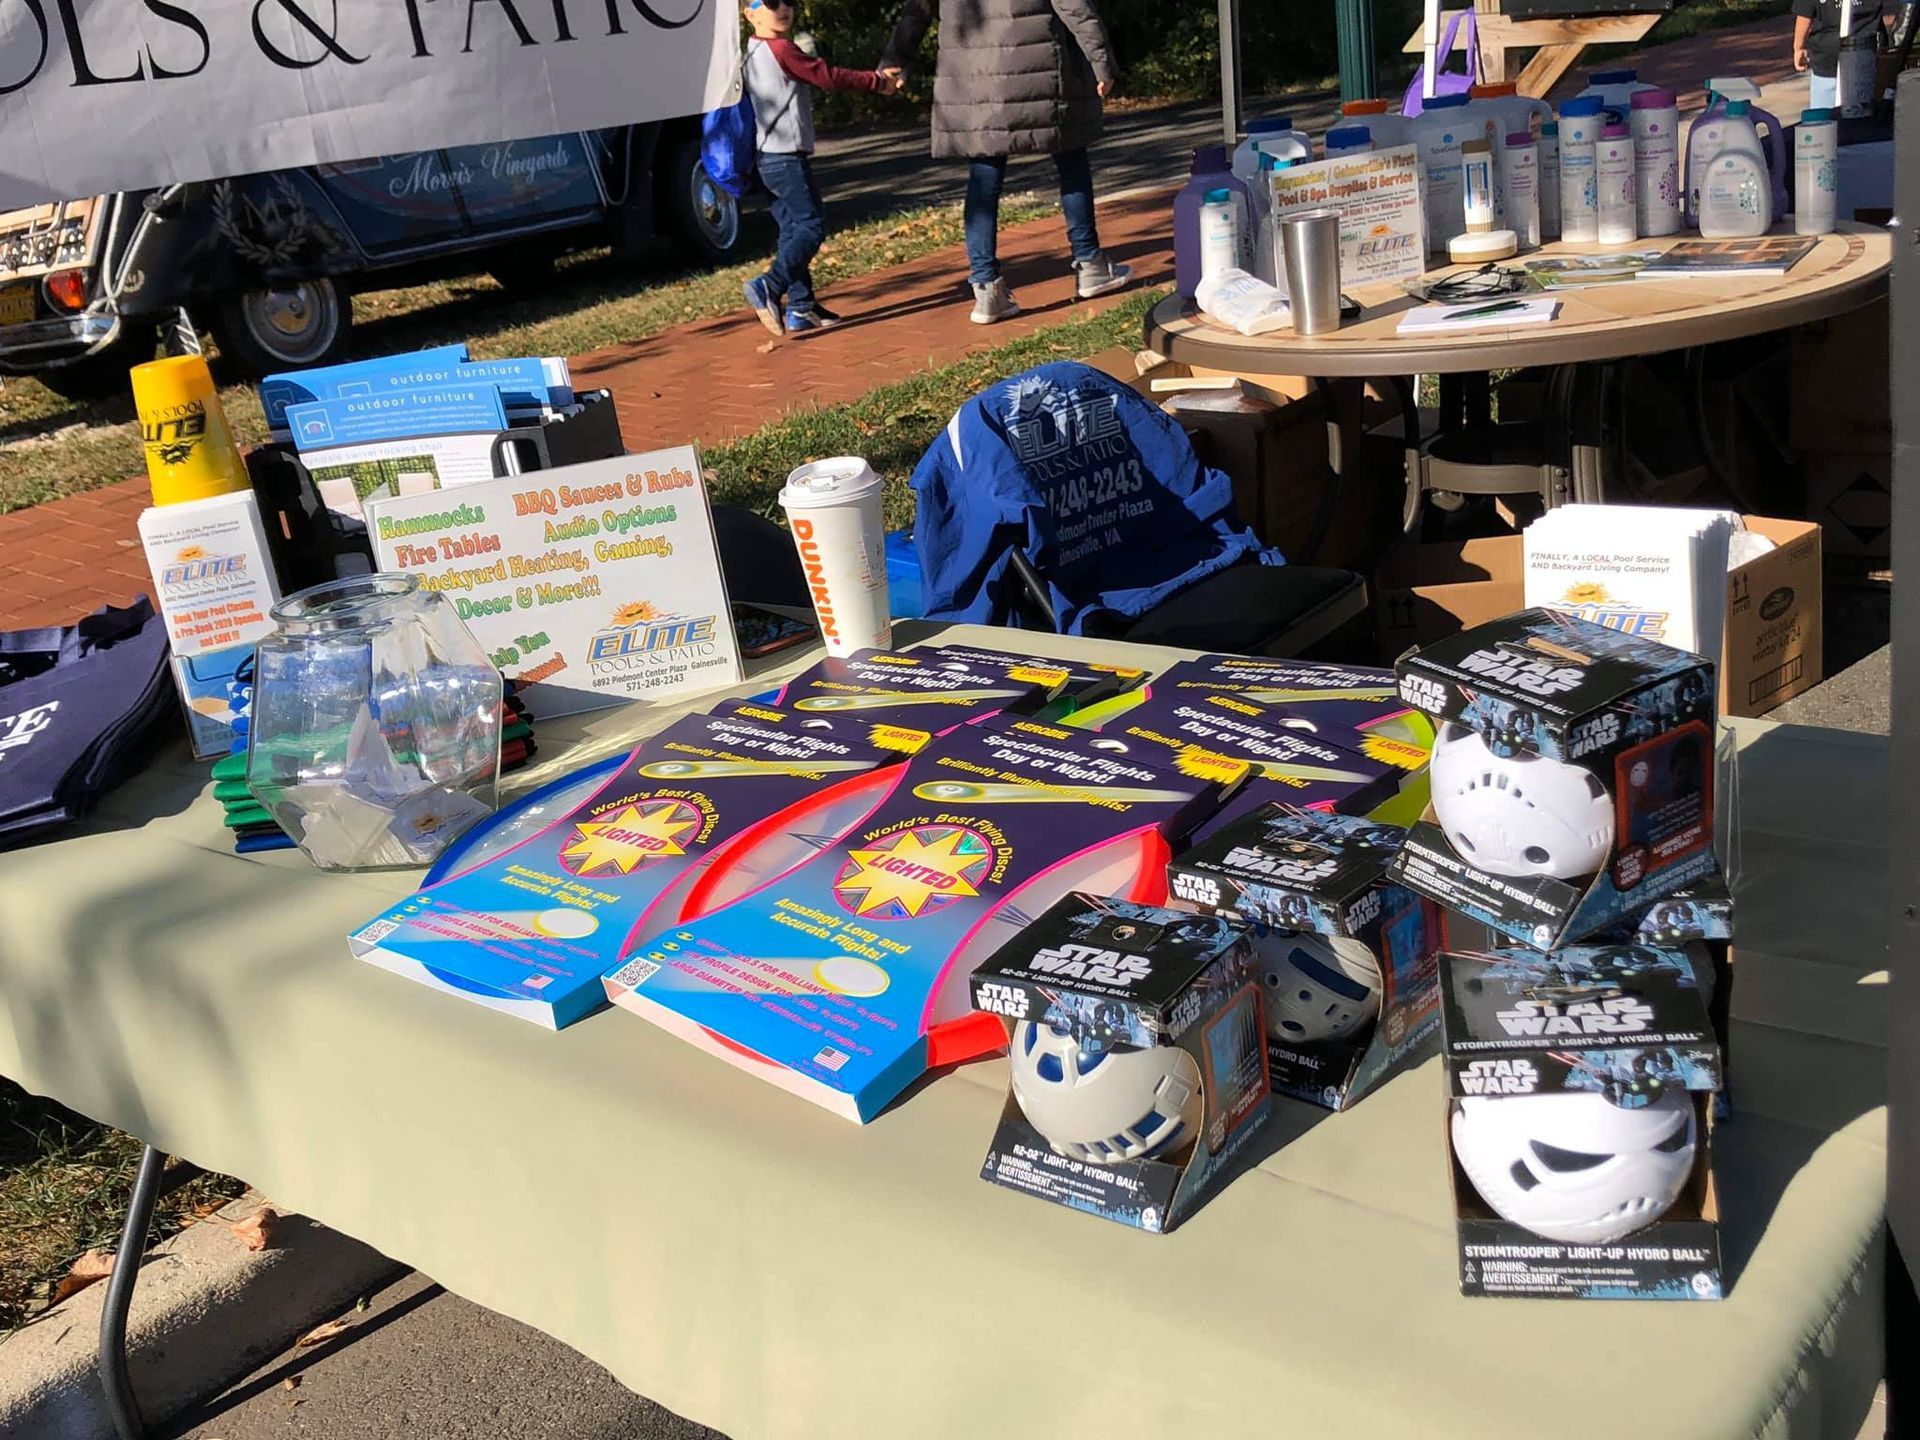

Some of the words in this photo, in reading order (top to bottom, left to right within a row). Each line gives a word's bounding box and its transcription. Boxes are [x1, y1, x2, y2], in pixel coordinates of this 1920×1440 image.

[481, 140, 570, 186] Vineyards
[1278, 192, 1300, 207] Pool
[1310, 187, 1327, 202] Spa
[1329, 181, 1368, 201] Supplies
[1379, 171, 1413, 188] Service
[390, 370, 449, 386] outdoor
[456, 363, 522, 379] furniture
[347, 396, 405, 412] outdoor
[412, 390, 476, 406] furniture
[143, 411, 206, 442] ELIT
[512, 488, 558, 517] BBQ
[560, 479, 624, 508] Sauces
[626, 472, 642, 497] &
[647, 466, 695, 494] Rubs
[377, 502, 486, 540] Hammocks
[543, 517, 600, 543] Audio
[602, 502, 678, 534] Options
[1118, 498, 1154, 521] Plaza
[394, 544, 437, 569] Fire
[438, 532, 502, 559] Tables
[1104, 527, 1122, 547] VA
[417, 557, 508, 594] Backyard
[508, 548, 591, 580] Heating,
[594, 534, 674, 563] Gaming,
[1531, 562, 1550, 570] AND
[1551, 562, 1591, 572] Backyard
[1594, 564, 1621, 573] Living
[1624, 565, 1670, 574] Company!
[1582, 554, 1609, 563] LOCAL
[210, 605, 226, 617] Pool
[455, 593, 513, 620] Decor
[516, 587, 532, 608] &
[538, 575, 602, 604] More!!!
[586, 615, 717, 664] ELITE
[590, 655, 645, 676] POOLS
[648, 652, 663, 665] &
[670, 642, 715, 662] PATIO
[592, 676, 611, 688] 6892
[611, 671, 645, 686] Piedmont
[645, 667, 667, 679] Center
[668, 664, 688, 676] Plaza
[690, 656, 729, 671] Gainesville
[626, 672, 685, 692] 571-248-2243
[847, 661, 936, 681] Spectacular
[938, 670, 995, 686] Flights
[858, 671, 886, 683] Day
[904, 675, 961, 691] Night!
[1209, 664, 1309, 683] Spectacular
[1314, 669, 1396, 685] Flights
[1228, 671, 1260, 681] Day
[1263, 675, 1284, 683] or
[1286, 674, 1360, 688] Night!
[1400, 673, 1447, 698] STAR
[1456, 653, 1584, 696] WARS
[734, 706, 787, 722] AEROBIE
[1400, 687, 1447, 715] WARS
[706, 719, 796, 743] Spectacular
[796, 735, 850, 755] Flights
[882, 729, 924, 742] LIGHTED
[1012, 721, 1074, 740] AEROBIE
[1125, 726, 1184, 748] Brilliantly
[1173, 705, 1276, 739] Spectacular
[1272, 732, 1340, 762] Flights
[1179, 720, 1215, 738] Day
[1216, 731, 1238, 743] or
[1238, 736, 1301, 762] Night!
[1570, 712, 1621, 744] STAR
[712, 732, 743, 748] Day
[745, 740, 762, 748] or
[762, 739, 815, 760] Night!
[1377, 739, 1426, 758] LIGHTED
[1570, 728, 1620, 758] WARS
[936, 756, 996, 779] Brilliantly
[982, 734, 1086, 767] Spectacular
[1088, 755, 1157, 784] Flights
[992, 748, 1027, 769] Day
[1030, 757, 1050, 769] or
[1052, 759, 1118, 785] Night!
[1191, 755, 1241, 771] LIGHTED
[591, 791, 651, 815] World's
[654, 788, 690, 798] Best
[689, 791, 716, 814] Flying
[695, 813, 720, 844] Discs!
[863, 816, 929, 841] World's
[934, 814, 973, 826] Best
[973, 819, 1006, 846] Flying
[591, 825, 668, 852] LIGHTED
[867, 854, 958, 890] LIGHTED
[989, 847, 1013, 884] Discs!
[500, 874, 552, 900] Accurate
[552, 887, 601, 911] Flights!
[505, 864, 563, 886] Amazingly
[563, 878, 593, 897] Long
[594, 889, 621, 904] and
[1172, 873, 1220, 895] STAR
[1173, 886, 1220, 907] WARS
[1464, 865, 1504, 895] LIGHT-UP
[1504, 884, 1531, 906] HYDRO
[770, 912, 831, 938] Accurate
[831, 932, 888, 959] Flights!
[774, 898, 843, 928] Amazingly
[842, 921, 876, 943] Long
[879, 938, 912, 955] and
[1028, 953, 1148, 987] WARS
[1035, 944, 1153, 974] STAR
[694, 969, 743, 996] DIAMETER
[701, 955, 738, 977] PROFILE
[738, 970, 772, 991] DESIGN
[779, 968, 827, 996] BRILLIANT
[977, 983, 1029, 1004] STAR
[977, 996, 1029, 1019] WARS
[1496, 997, 1654, 1020] STAR
[1497, 1014, 1654, 1036] WARS
[1558, 1036, 1617, 1047] LIGHT-UP
[1619, 1034, 1663, 1045] HYDRO
[1269, 1046, 1297, 1063] HYDRO
[1459, 1059, 1538, 1078] STAR
[1460, 1076, 1538, 1094] WARS
[1043, 1151, 1083, 1173] LIGHT-UP
[1084, 1166, 1115, 1185] HYDRO
[1482, 1261, 1529, 1273] WARNING:
[1567, 1247, 1624, 1259] LIGHT-UP
[1627, 1248, 1669, 1261] HYDRO
